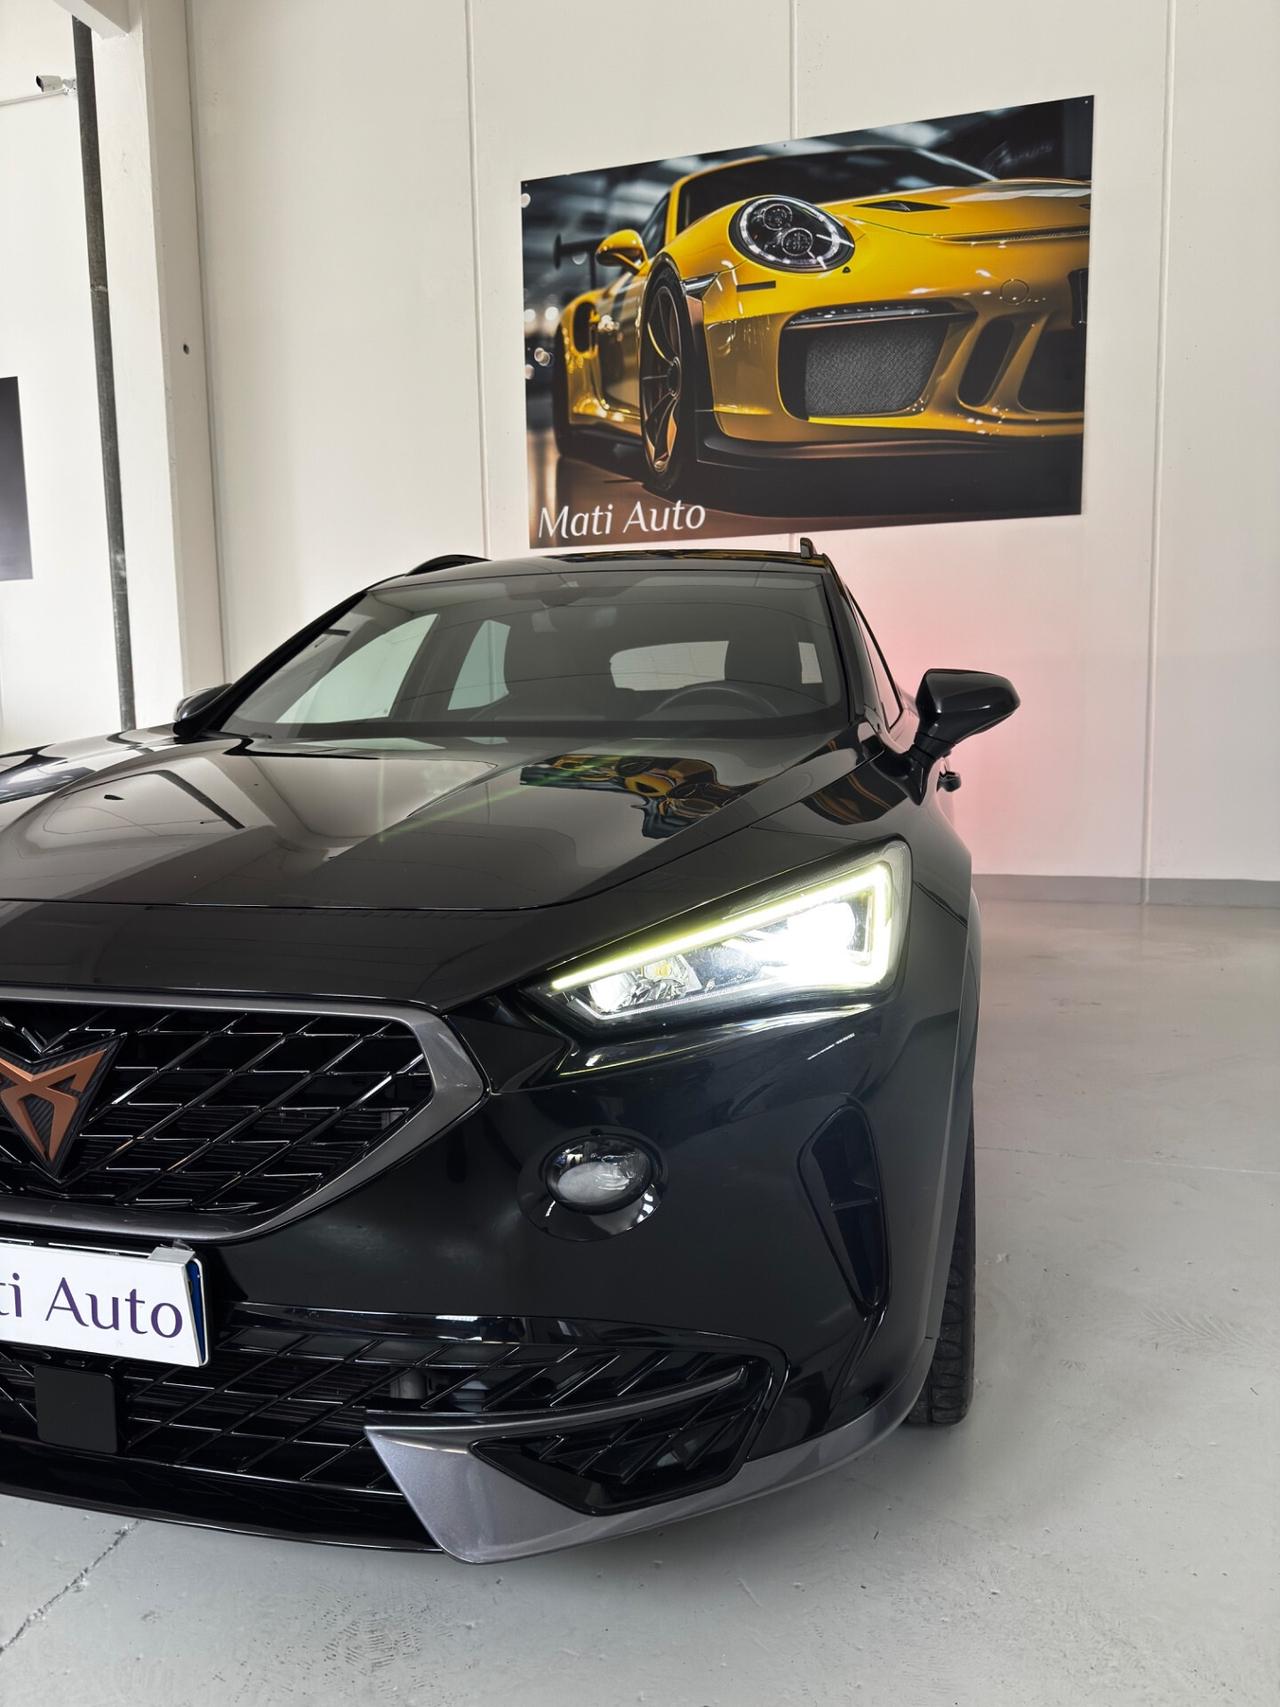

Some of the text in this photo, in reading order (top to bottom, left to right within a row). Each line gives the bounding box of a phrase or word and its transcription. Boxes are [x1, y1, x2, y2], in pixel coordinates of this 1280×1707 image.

[538, 499, 706, 539] Mati Auto
[45, 1276, 183, 1339] Auto
